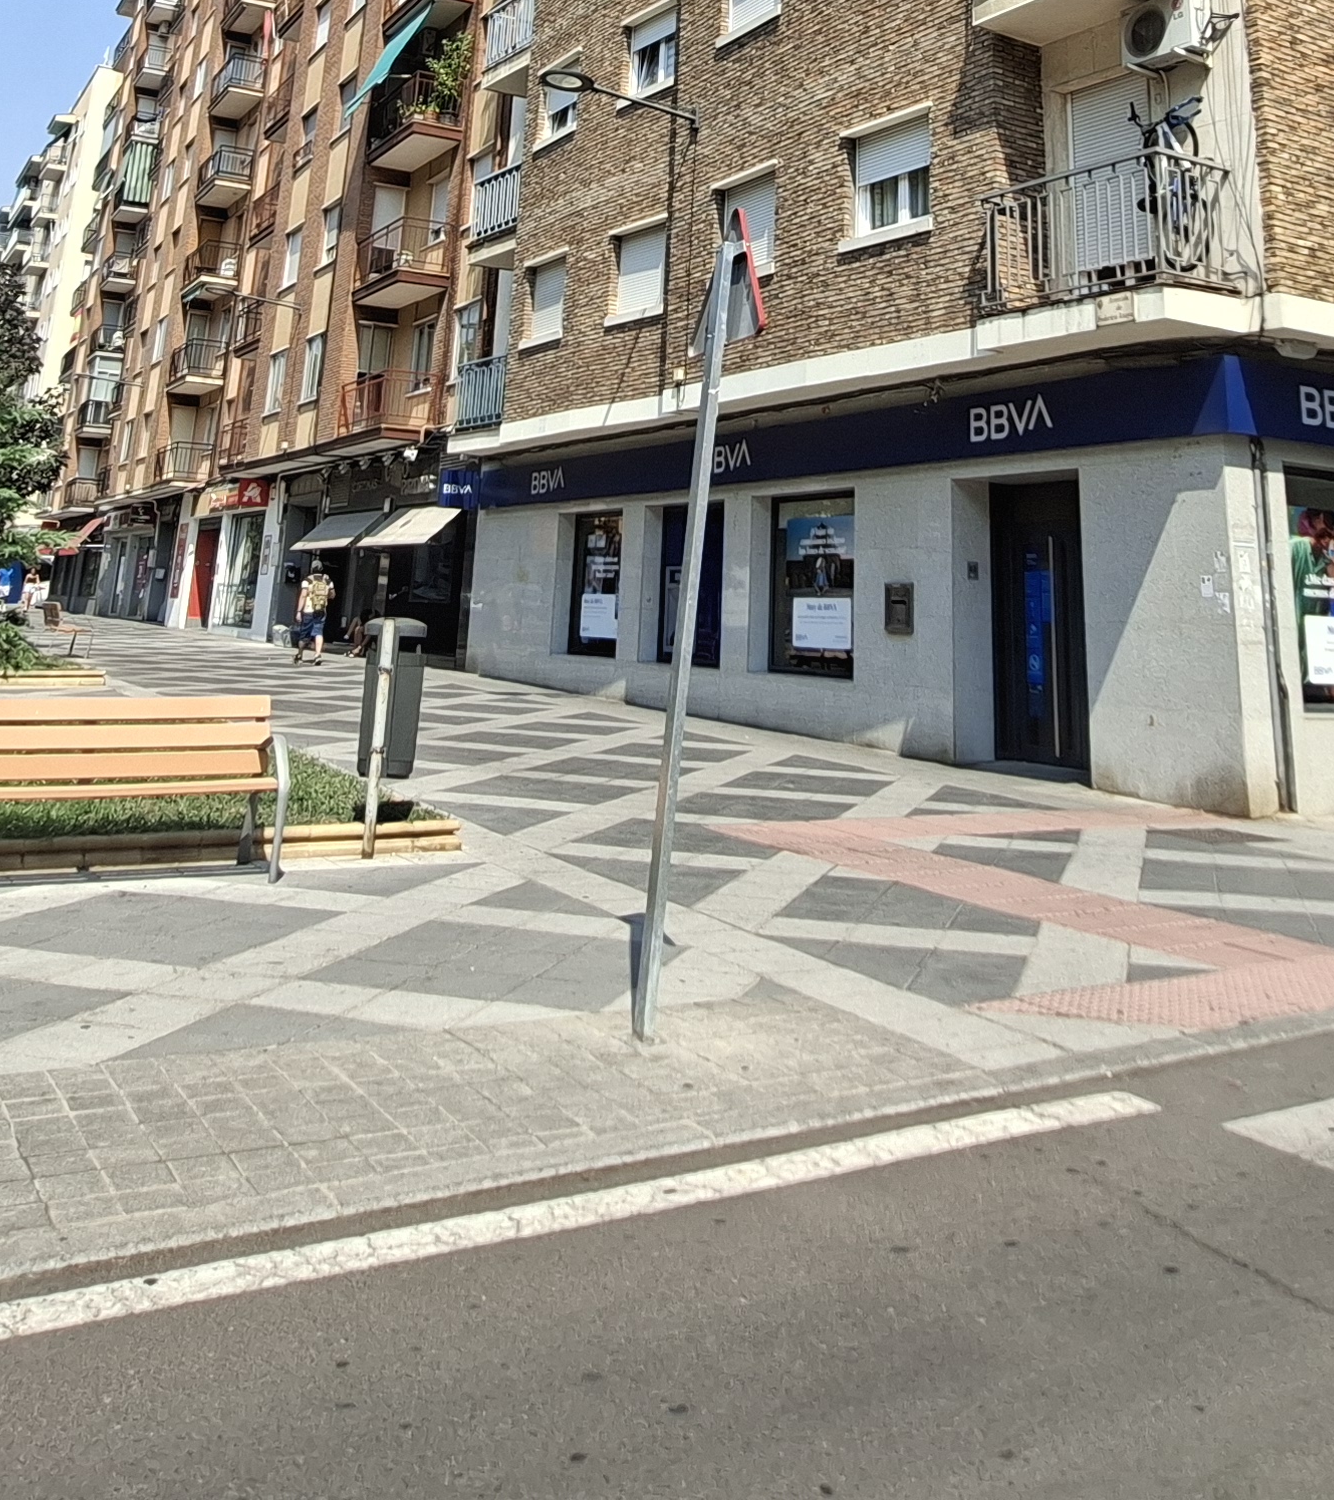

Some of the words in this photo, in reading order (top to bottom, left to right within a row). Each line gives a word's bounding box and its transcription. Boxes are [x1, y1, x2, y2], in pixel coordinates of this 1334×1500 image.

[970, 393, 1053, 442] BBVA
[713, 439, 751, 474] BVA
[443, 483, 473, 495] BBVA
[531, 466, 564, 495] BBVA
